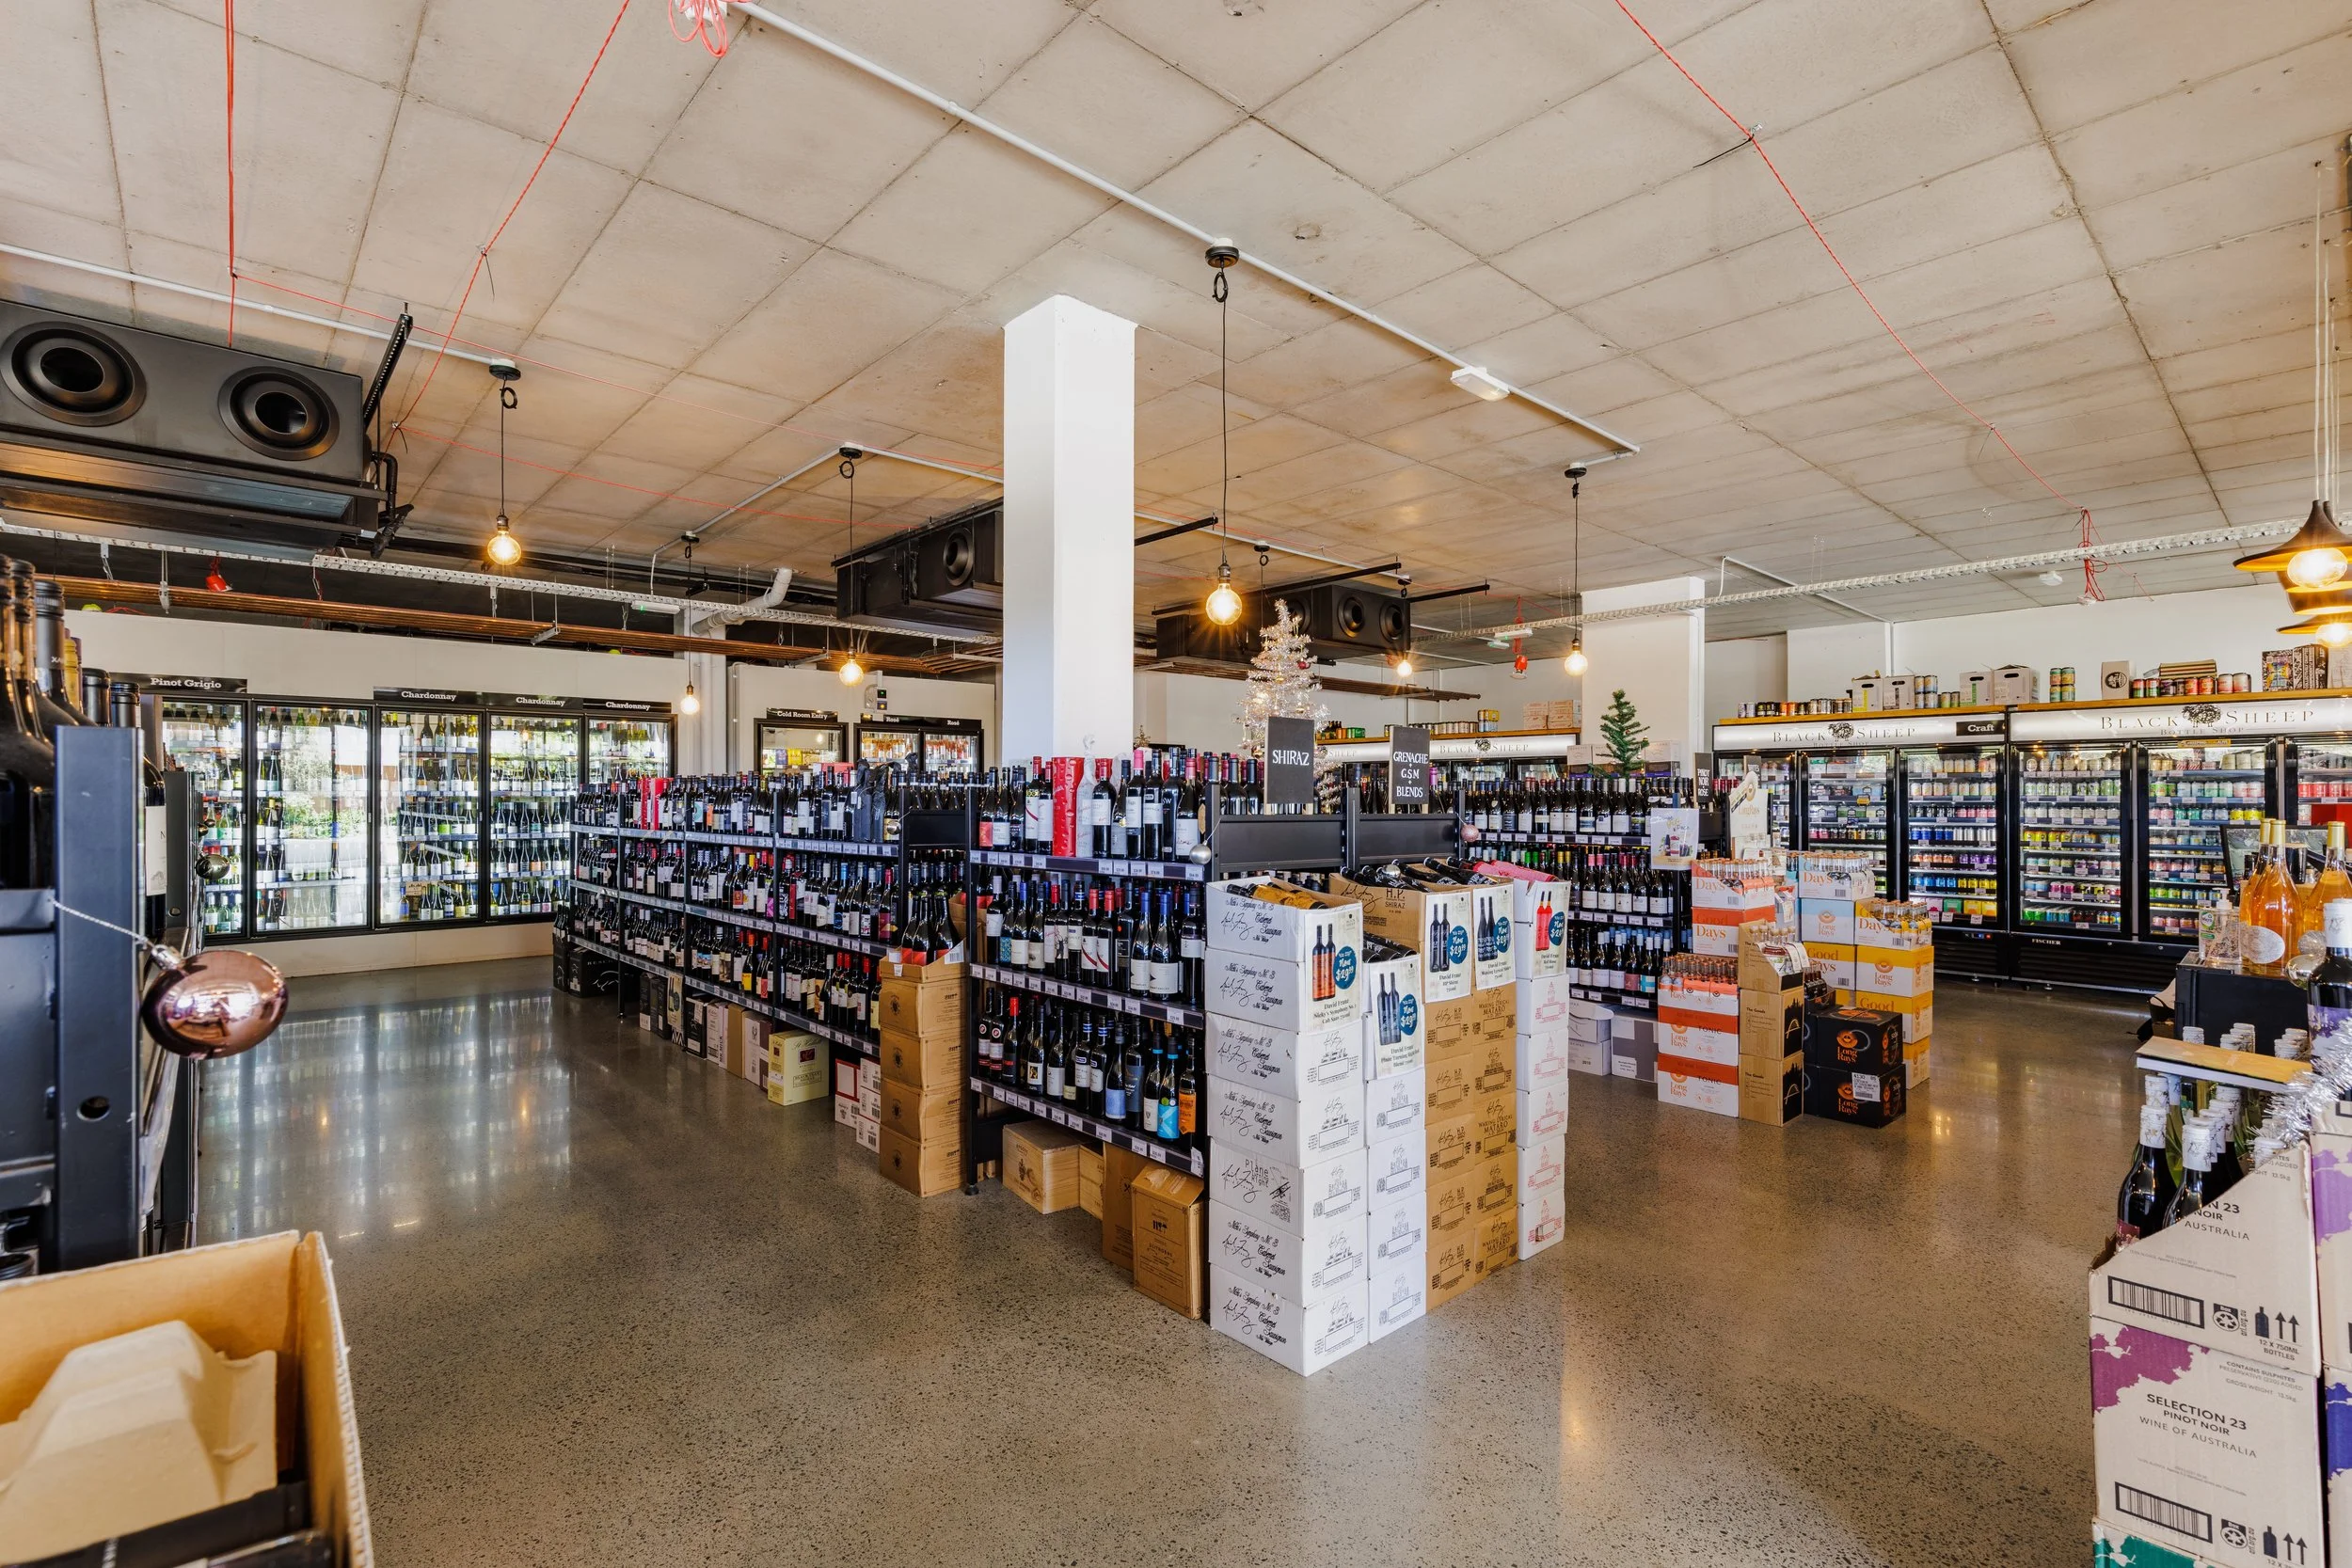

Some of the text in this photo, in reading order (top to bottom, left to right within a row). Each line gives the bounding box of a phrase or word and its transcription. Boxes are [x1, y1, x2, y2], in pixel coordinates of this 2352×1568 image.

[151, 677, 222, 689] Pinot Grigio
[401, 689, 456, 702] Chardonnay
[516, 696, 565, 706] Chardonnay
[605, 701, 651, 710] Chardonnay
[810, 712, 828, 721] Entry
[2102, 709, 2314, 730] BLACK SHEEP
[1967, 723, 1995, 733] Craft
[1772, 727, 1916, 743] BLACK SHEEP
[1491, 742, 1529, 752] SHEEP
[1272, 749, 1310, 766] SHIRAZ
[1393, 752, 1429, 765] GRENACHE
[1396, 785, 1423, 799] BLENDS
[1695, 878, 1725, 891] Days
[1804, 872, 1833, 886] Days
[1696, 913, 1728, 926] Good
[1696, 926, 1726, 941] Days
[1807, 947, 1839, 960] Good
[1874, 972, 1894, 982] Long
[1874, 978, 1892, 988] Rays
[1670, 990, 1686, 1001] Rays
[1324, 1001, 1337, 1009] David
[1483, 1006, 1505, 1015] MATARO
[1860, 997, 1895, 1012] Good
[1698, 1025, 1723, 1035] TONIC
[1671, 1033, 1688, 1043] Long
[1671, 1039, 1687, 1049] Rays
[1837, 1046, 1858, 1057] Long
[1837, 1053, 1856, 1064] Rays
[1697, 1075, 1722, 1085] TONIC
[1670, 1082, 1687, 1093] Long
[1670, 1088, 1686, 1099] Rays
[1838, 1099, 1858, 1110] Long
[1838, 1105, 1857, 1116] Rays
[1484, 1121, 1509, 1133] MATARO
[1245, 1159, 1269, 1176] Plane
[2223, 1202, 2240, 1214] 23
[2193, 1209, 2224, 1222] NOIR
[2185, 1220, 2250, 1242] AUSTRALIA
[1486, 1237, 1510, 1251] MATARO
[2264, 1347, 2296, 1361] BOTTLES
[2276, 1343, 2299, 1354] 750ML
[2219, 1365, 2304, 1391] PRESERVATIVE ADDED
[2226, 1361, 2296, 1383] CONTAINS SULPHITES
[2225, 1377, 2248, 1388] GROSS
[2248, 1384, 2273, 1395] WEIGHT
[2147, 1393, 2247, 1431] SELECTION 23
[2163, 1410, 2230, 1436] PINOT NOIR
[2139, 1416, 2257, 1458] WINE OF AUSTRALIA
